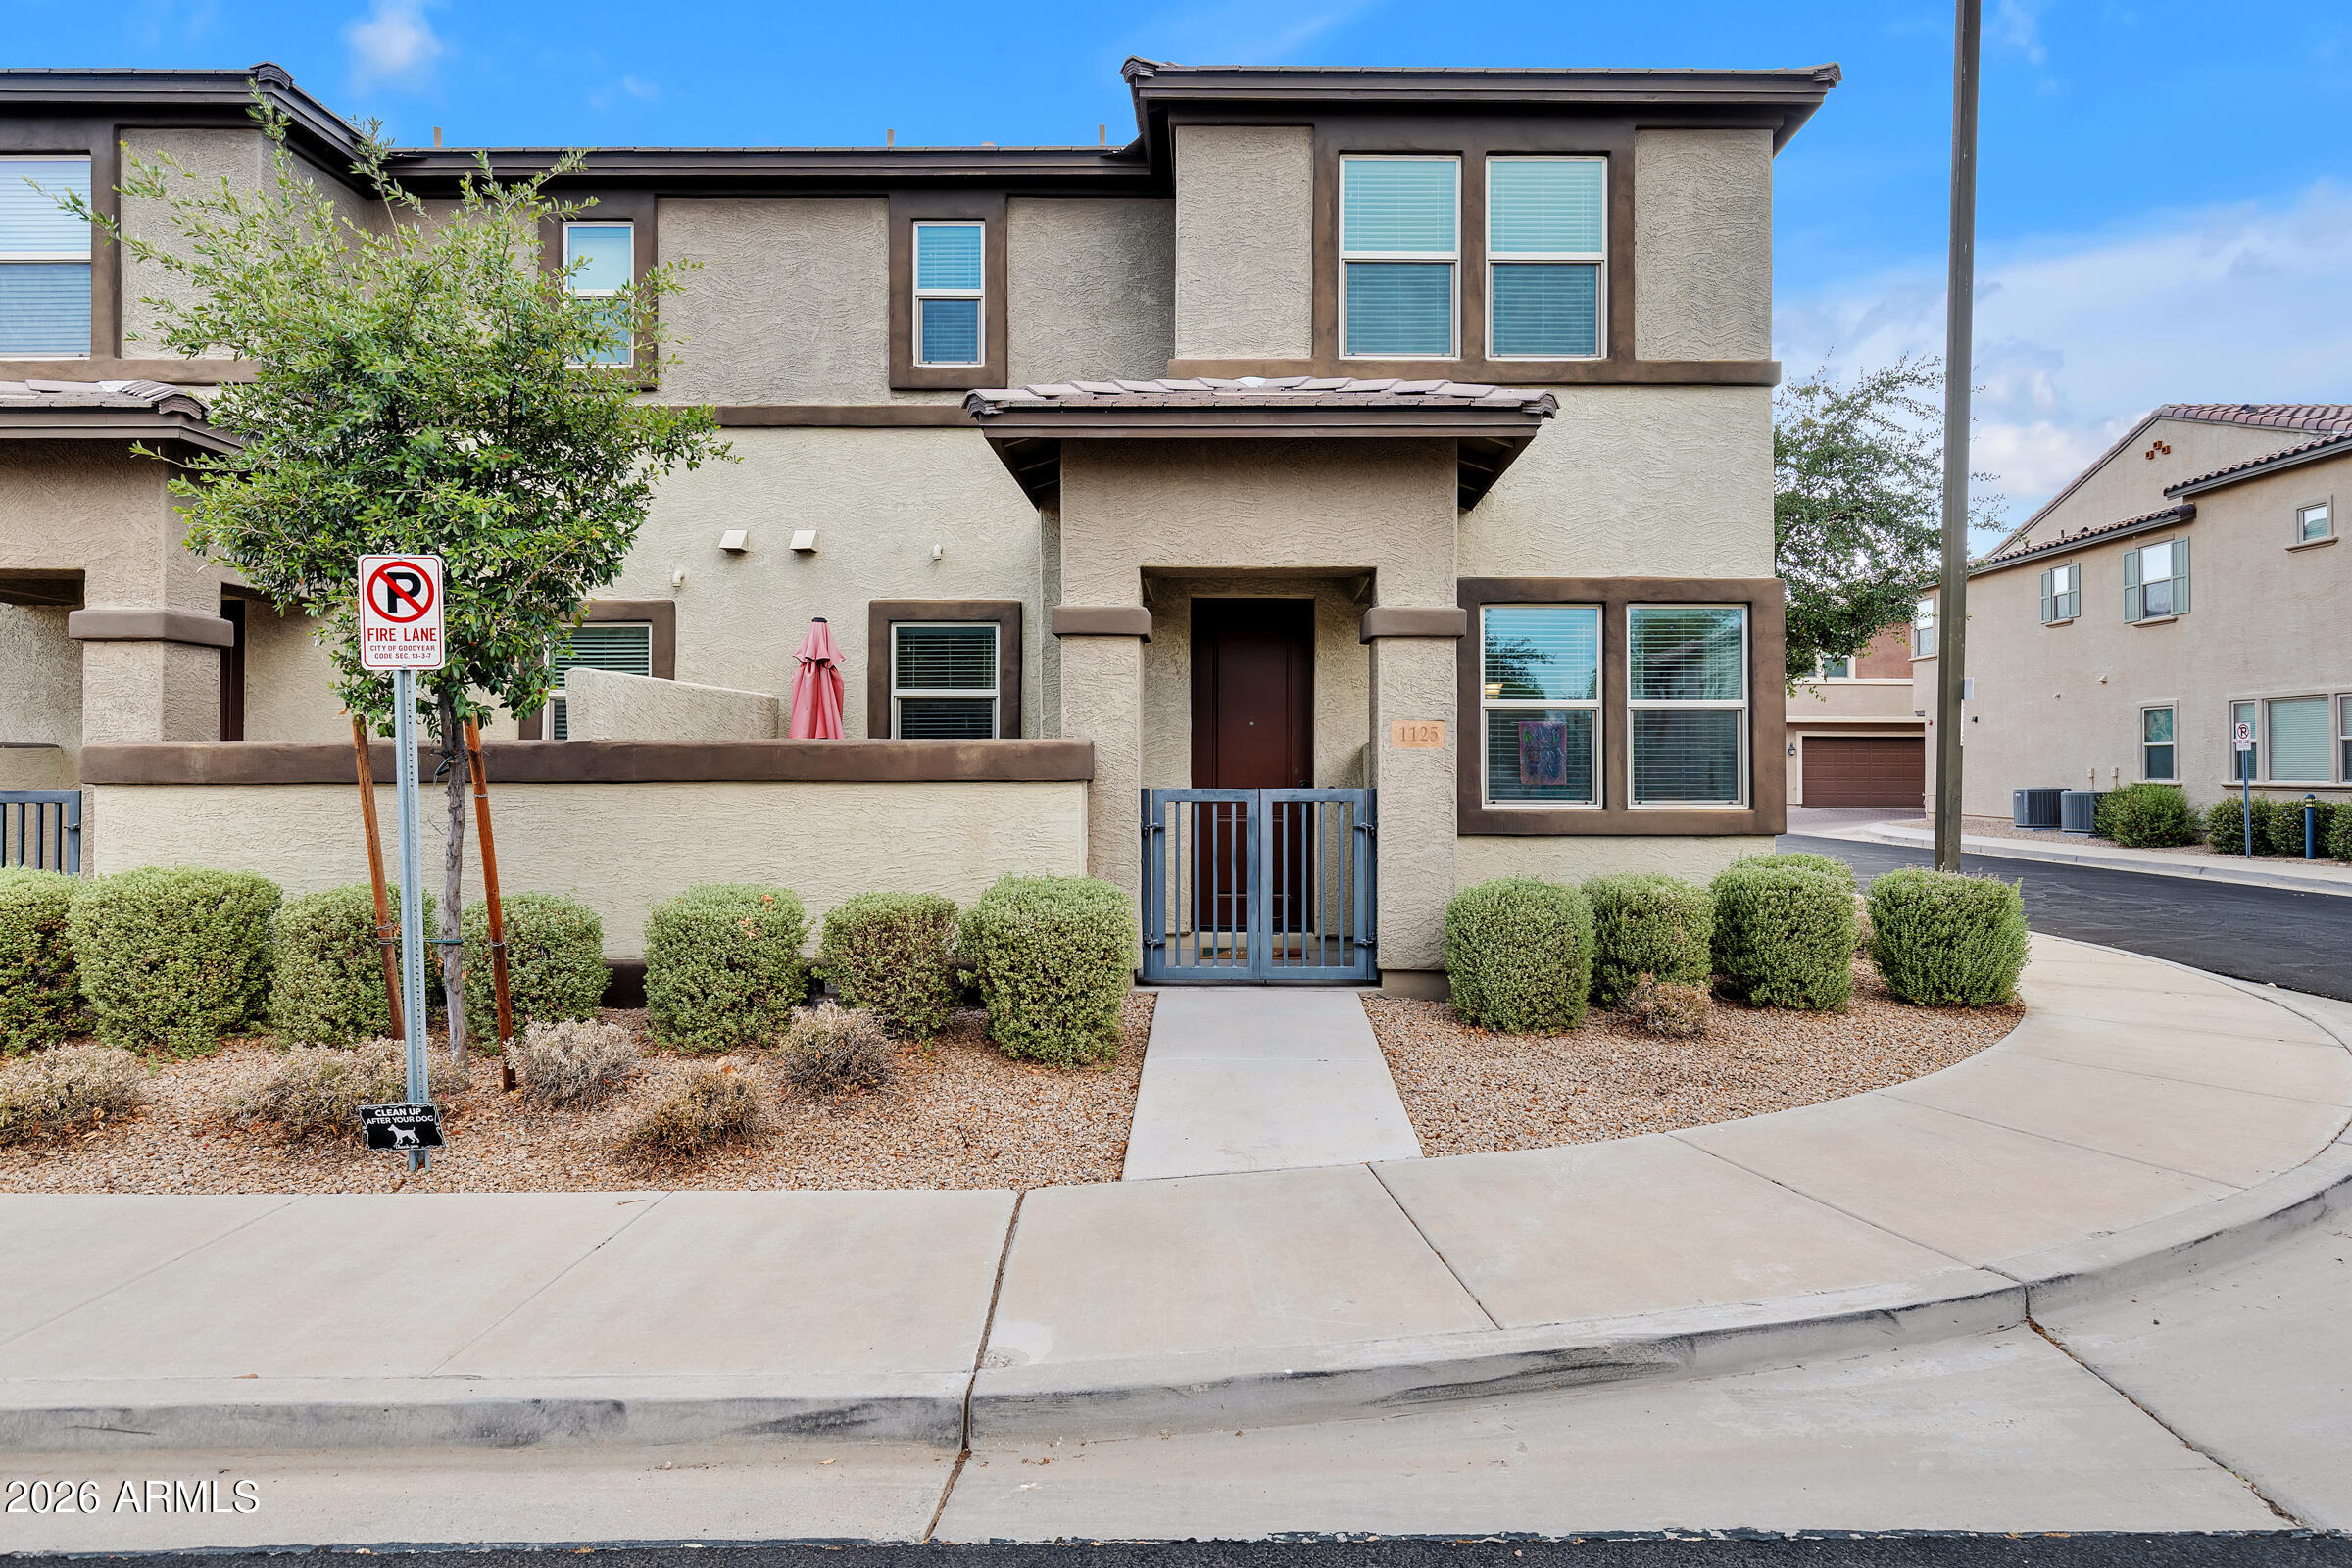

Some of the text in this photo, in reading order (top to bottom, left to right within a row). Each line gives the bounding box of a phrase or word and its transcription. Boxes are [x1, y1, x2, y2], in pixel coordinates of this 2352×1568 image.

[368, 628, 437, 642] FIRE LANE
[1399, 726, 1438, 742] 1125
[374, 1108, 407, 1117] CLEAN
